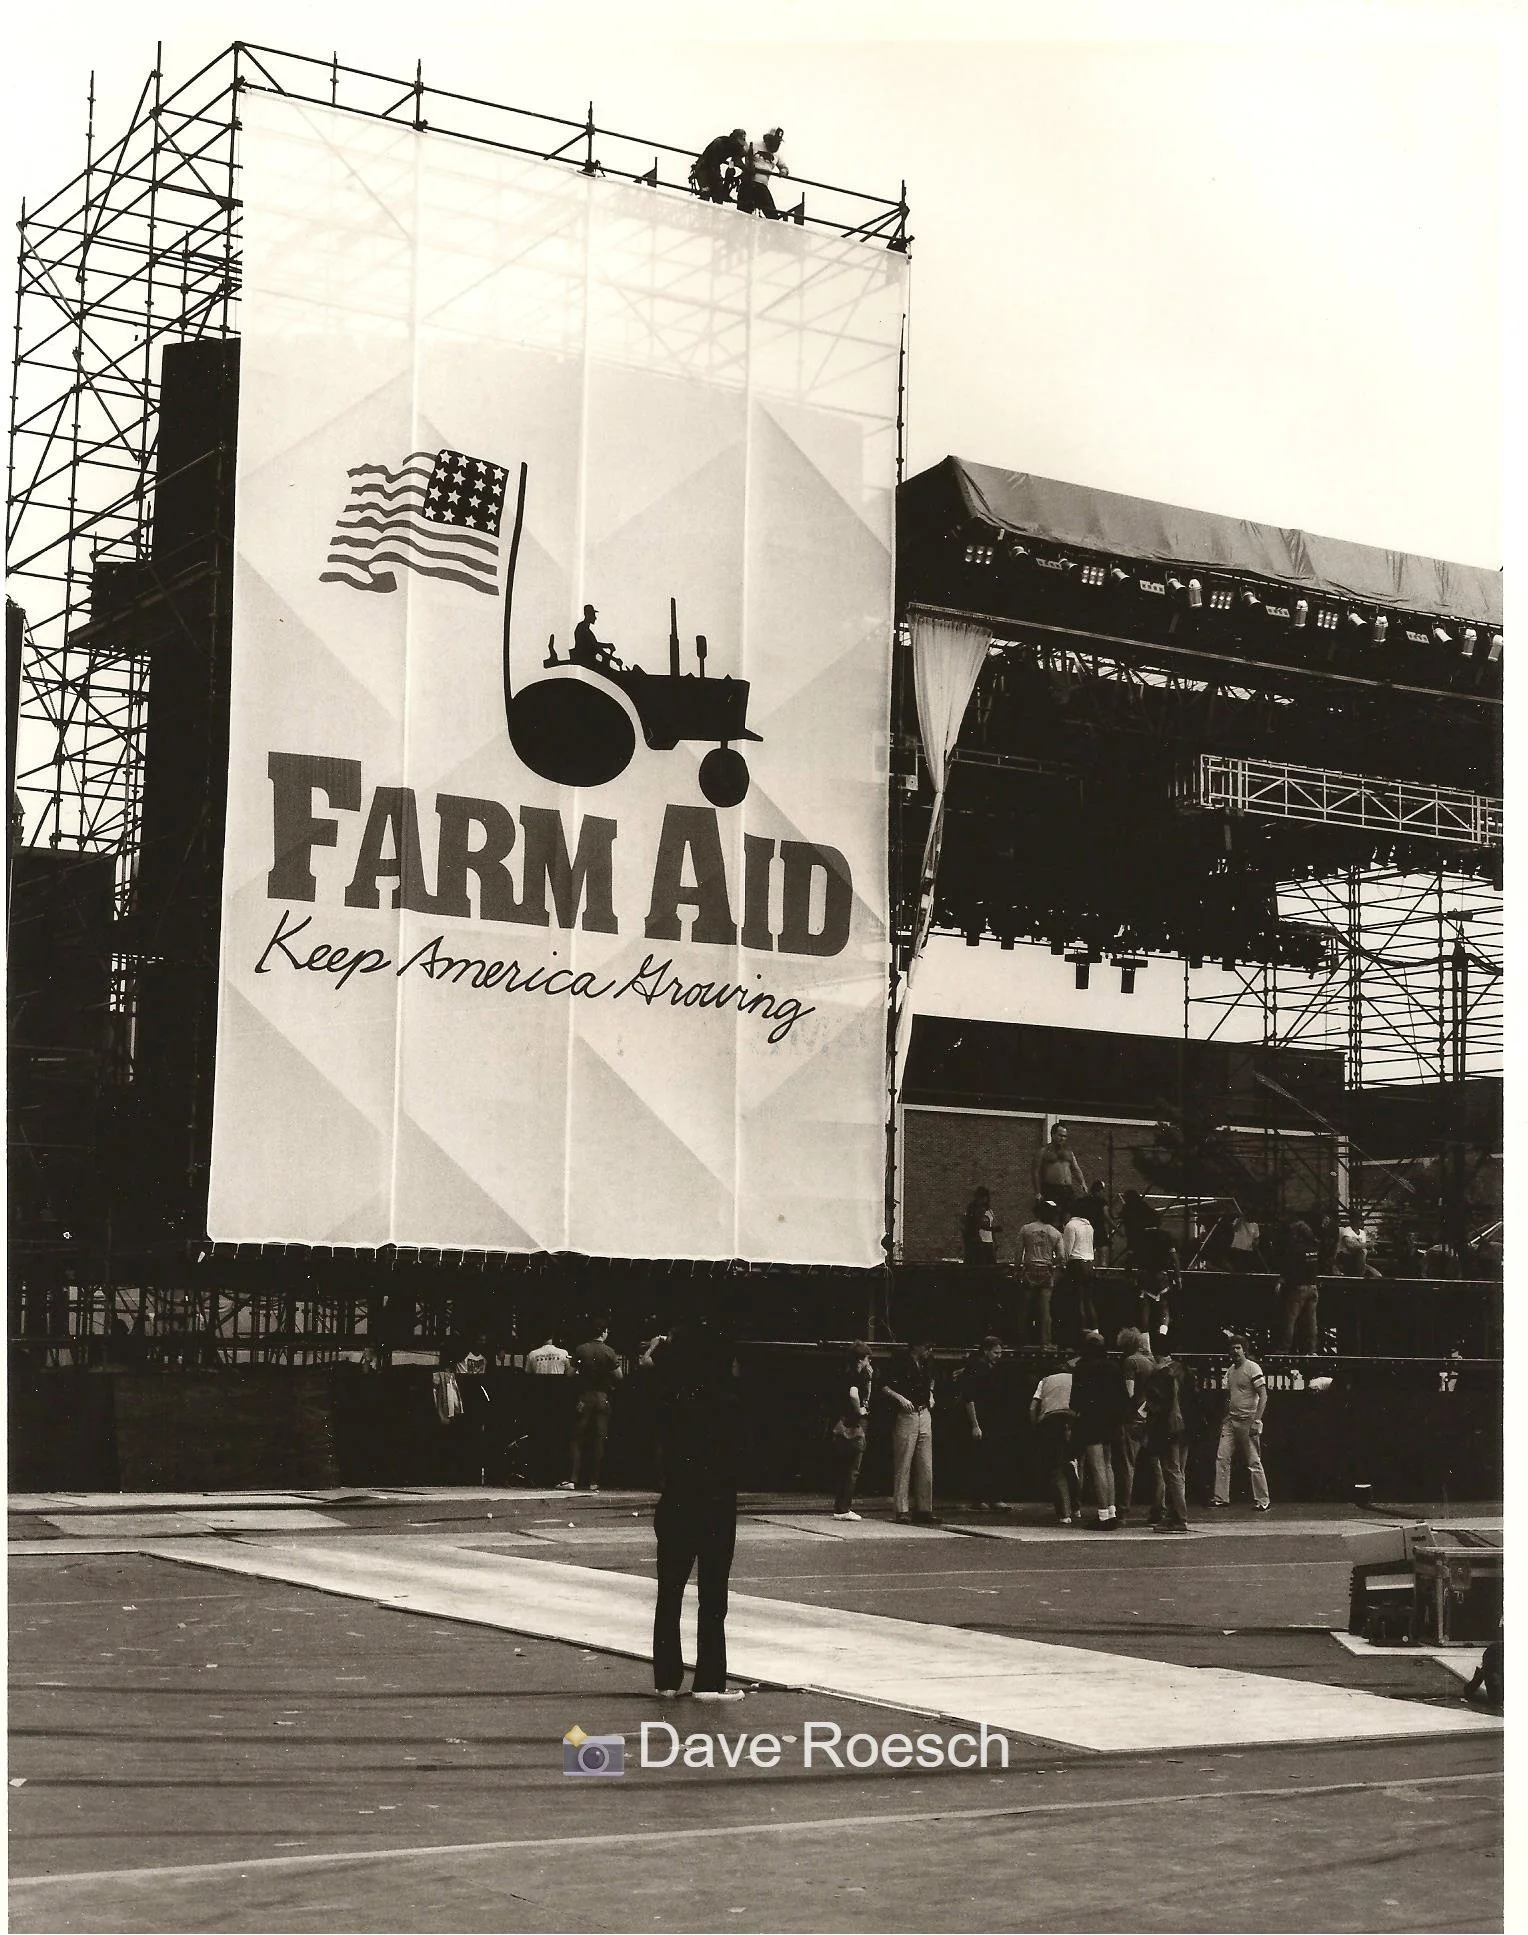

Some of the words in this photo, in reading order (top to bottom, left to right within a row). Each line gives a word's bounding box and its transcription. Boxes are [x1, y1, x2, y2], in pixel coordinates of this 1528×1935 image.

[267, 751, 619, 933] FARM
[644, 804, 853, 957] AID
[254, 909, 391, 991] Keep
[397, 935, 617, 999] America
[613, 954, 816, 1044] Growing
